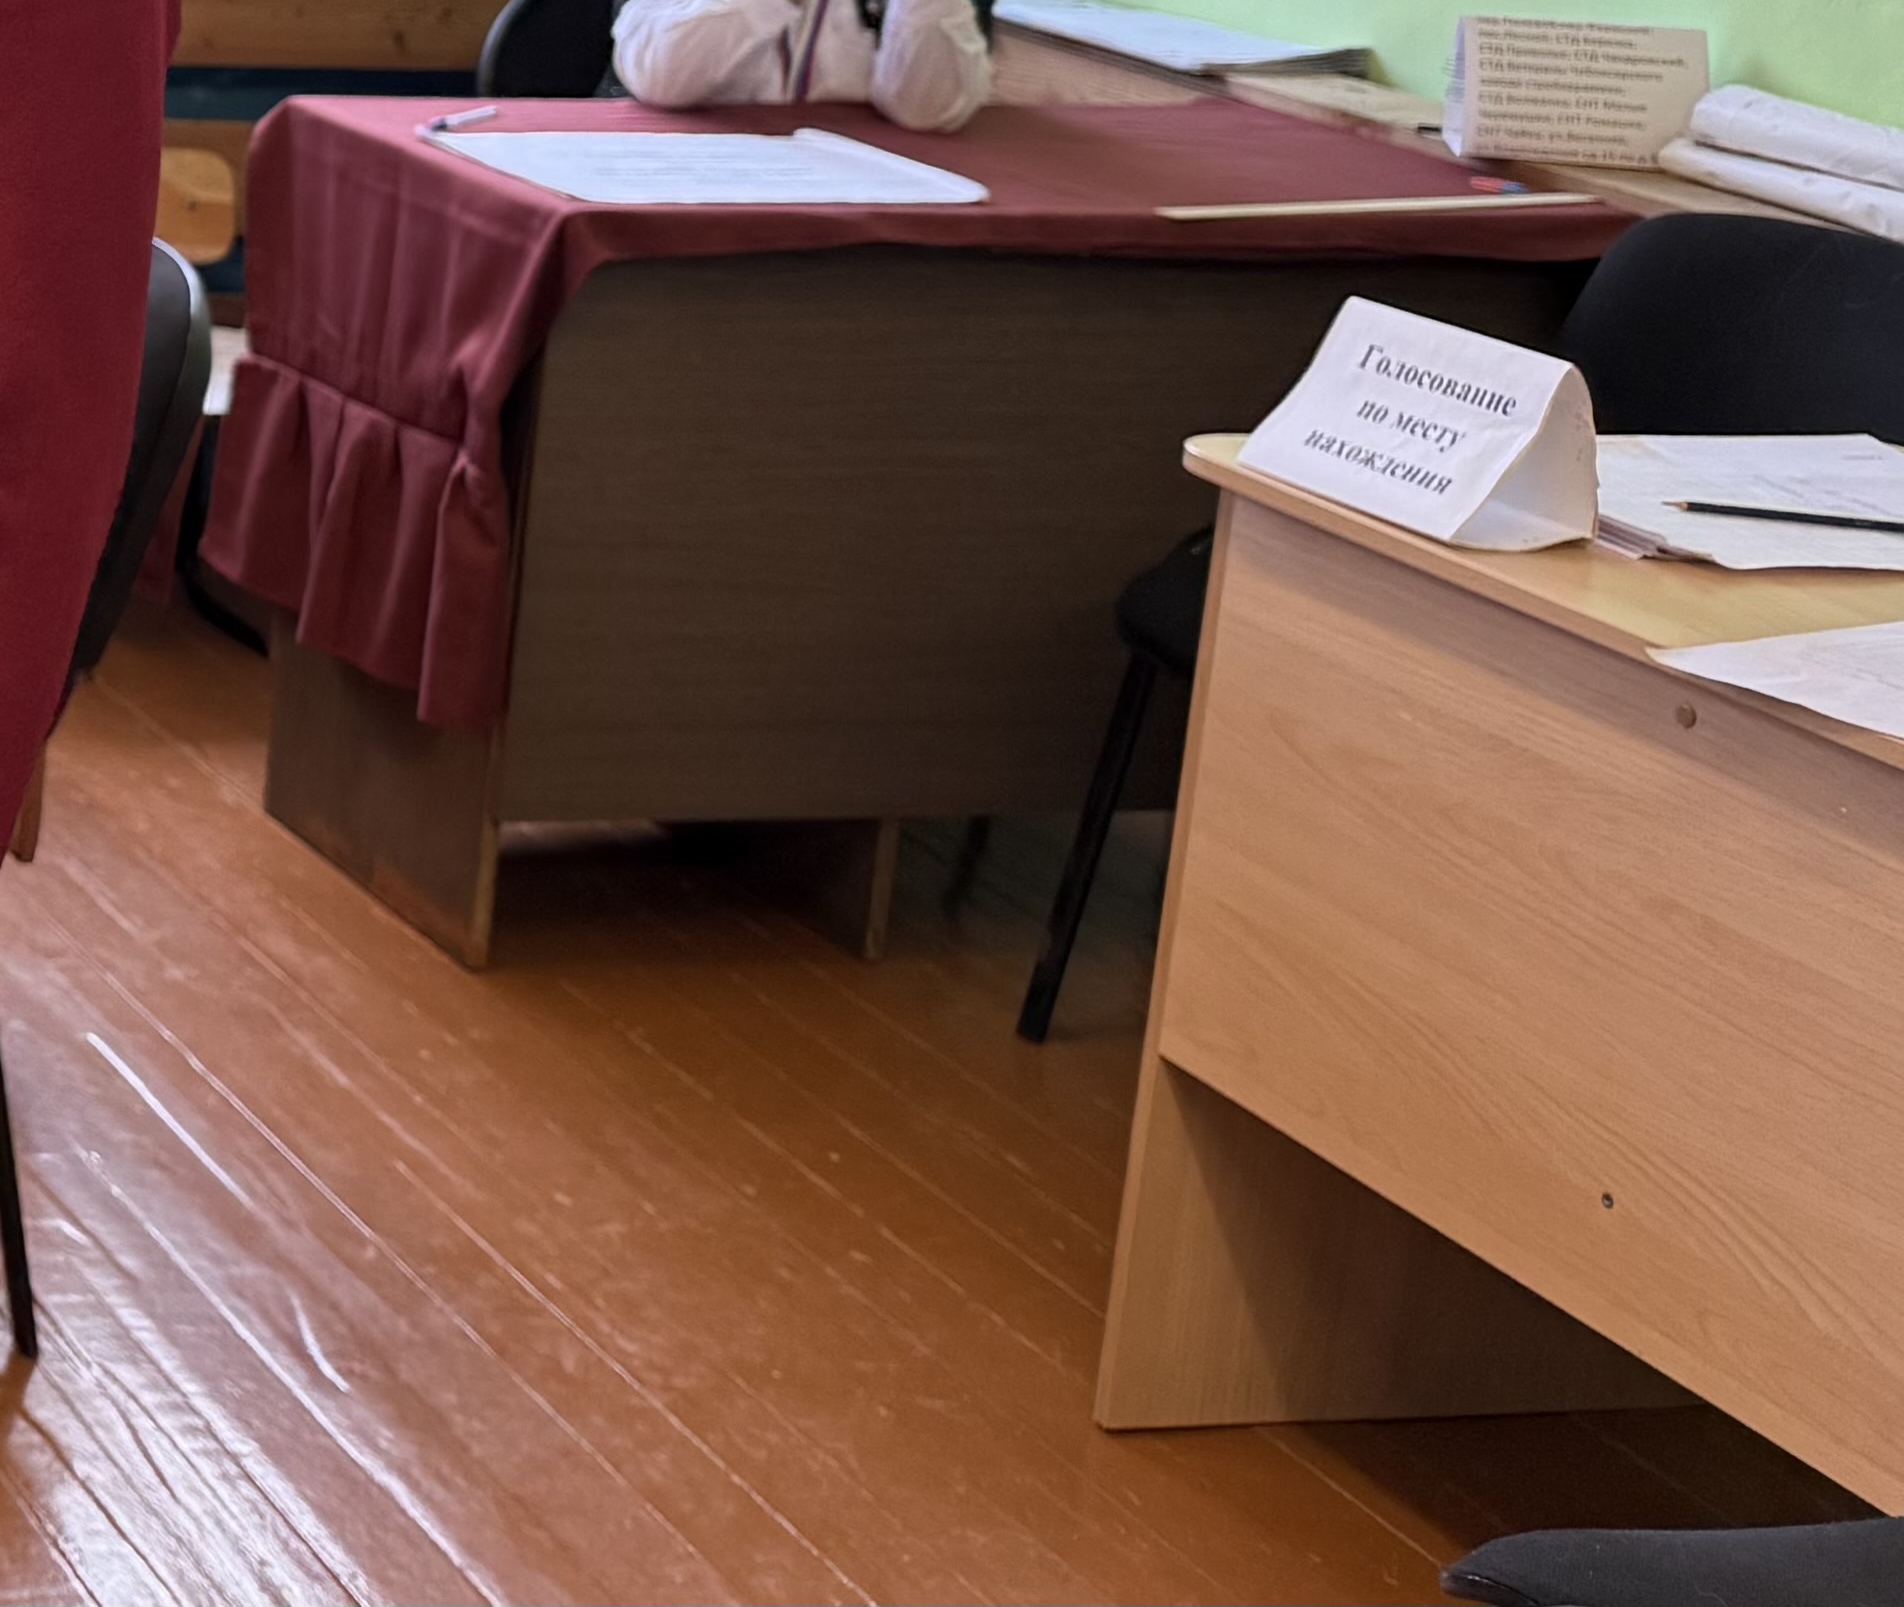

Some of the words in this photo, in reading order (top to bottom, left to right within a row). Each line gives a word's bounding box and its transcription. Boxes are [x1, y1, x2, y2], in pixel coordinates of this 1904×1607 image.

[1357, 343, 1517, 417] Голосование
[1355, 398, 1390, 426] по
[1389, 409, 1468, 454] месту
[1303, 428, 1454, 496] нахождения
